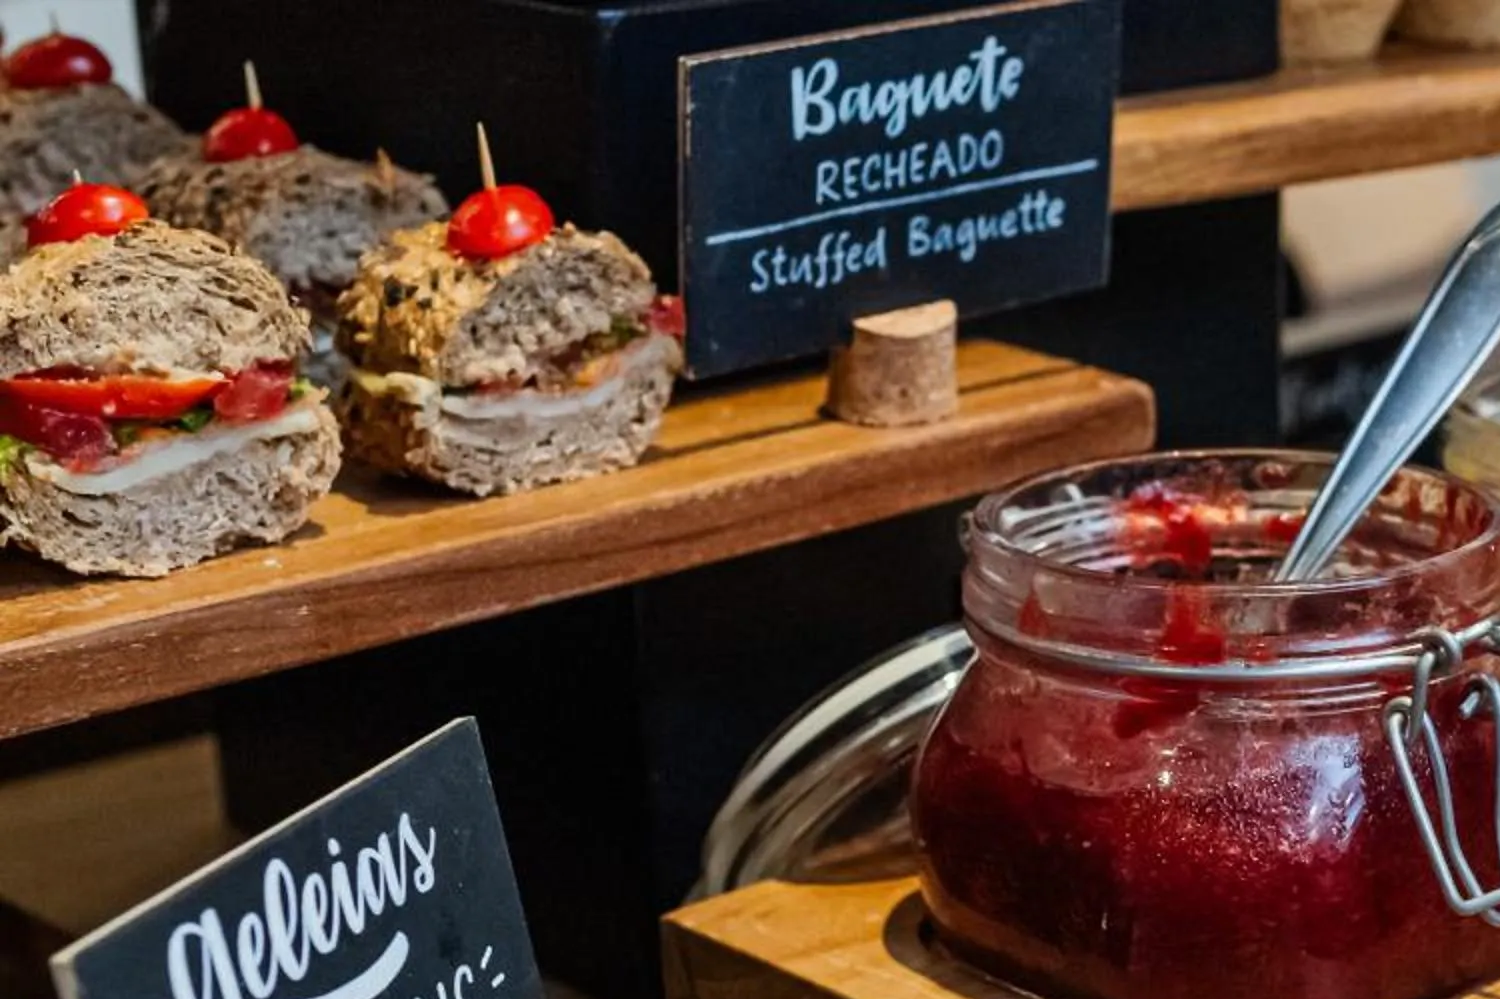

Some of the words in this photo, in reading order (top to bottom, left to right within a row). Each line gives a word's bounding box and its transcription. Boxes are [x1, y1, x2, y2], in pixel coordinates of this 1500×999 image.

[791, 35, 1024, 141] Baguete
[815, 129, 1003, 205] RECHEADO
[750, 227, 887, 293] Stuffed
[908, 189, 1065, 262] Baguette
